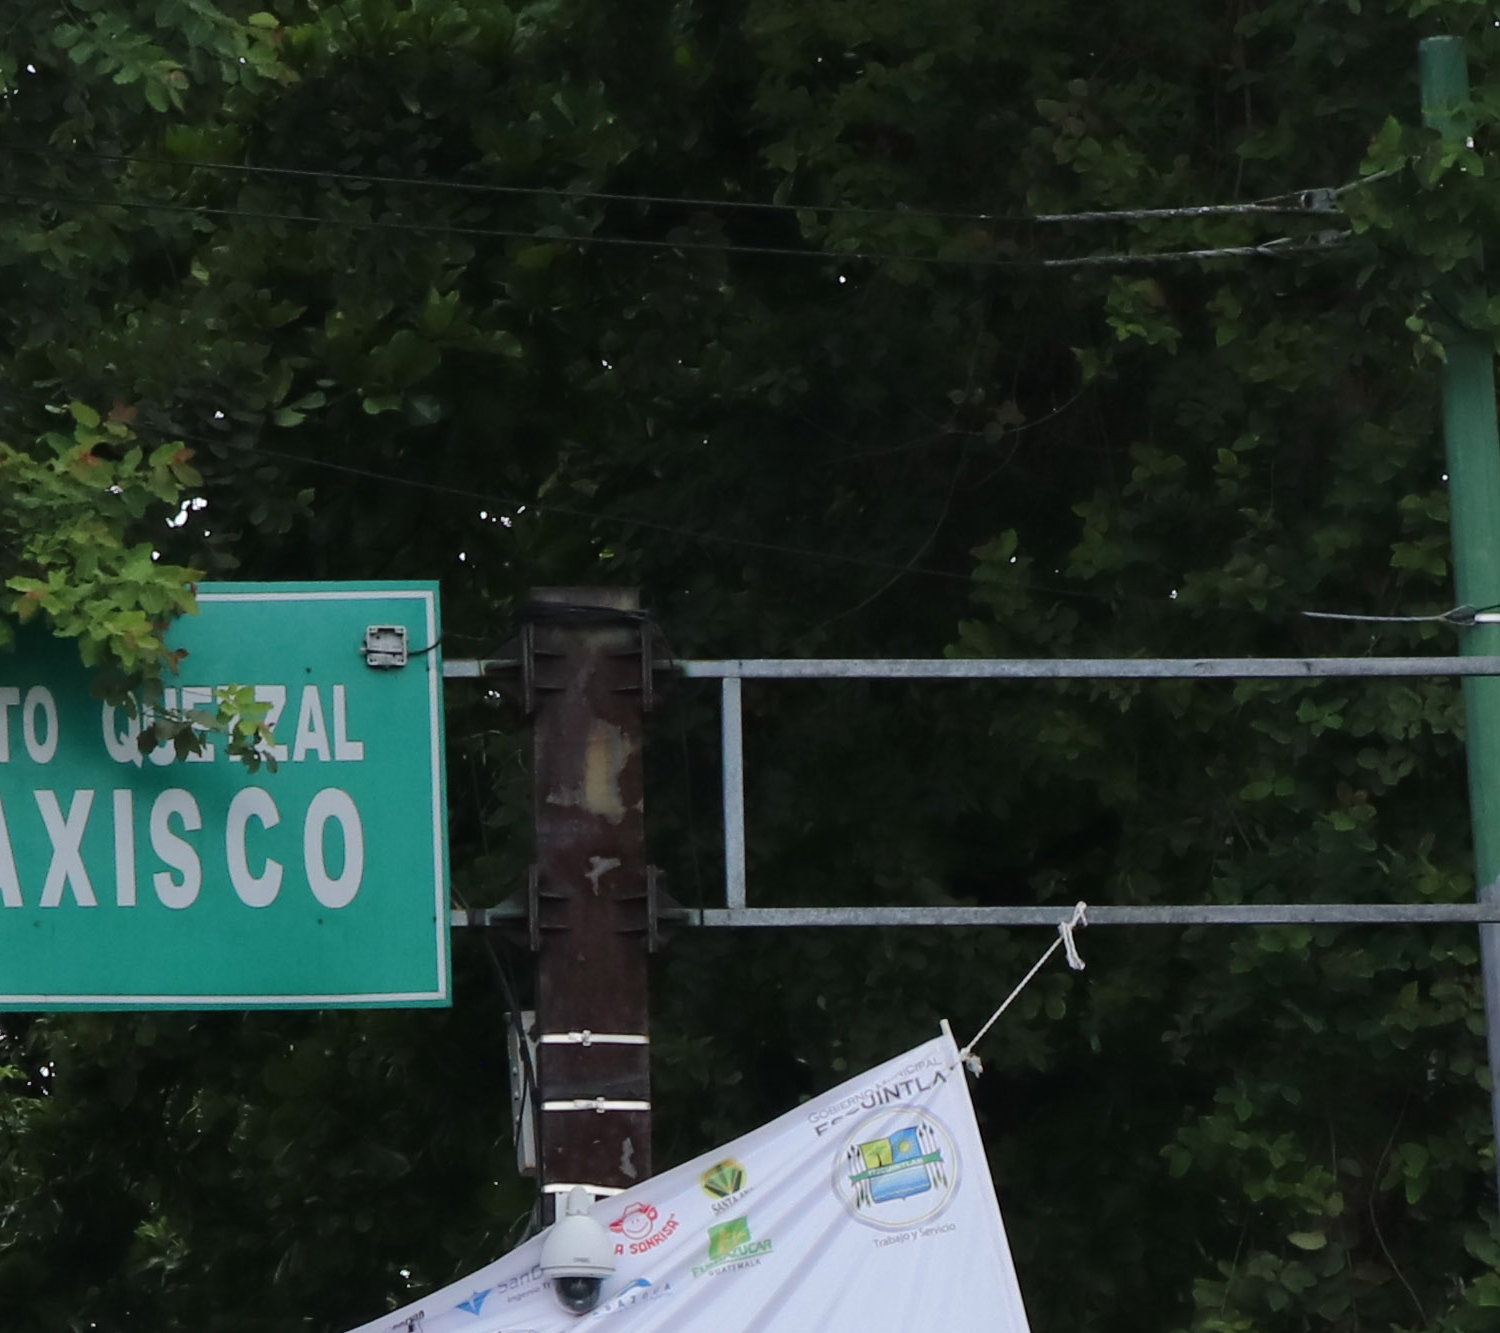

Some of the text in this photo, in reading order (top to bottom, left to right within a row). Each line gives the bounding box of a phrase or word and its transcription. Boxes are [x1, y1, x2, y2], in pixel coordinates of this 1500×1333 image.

[630, 1216, 679, 1255] SONRISA
[873, 1231, 910, 1249] Trabajo
[919, 1222, 956, 1238] Servicio
